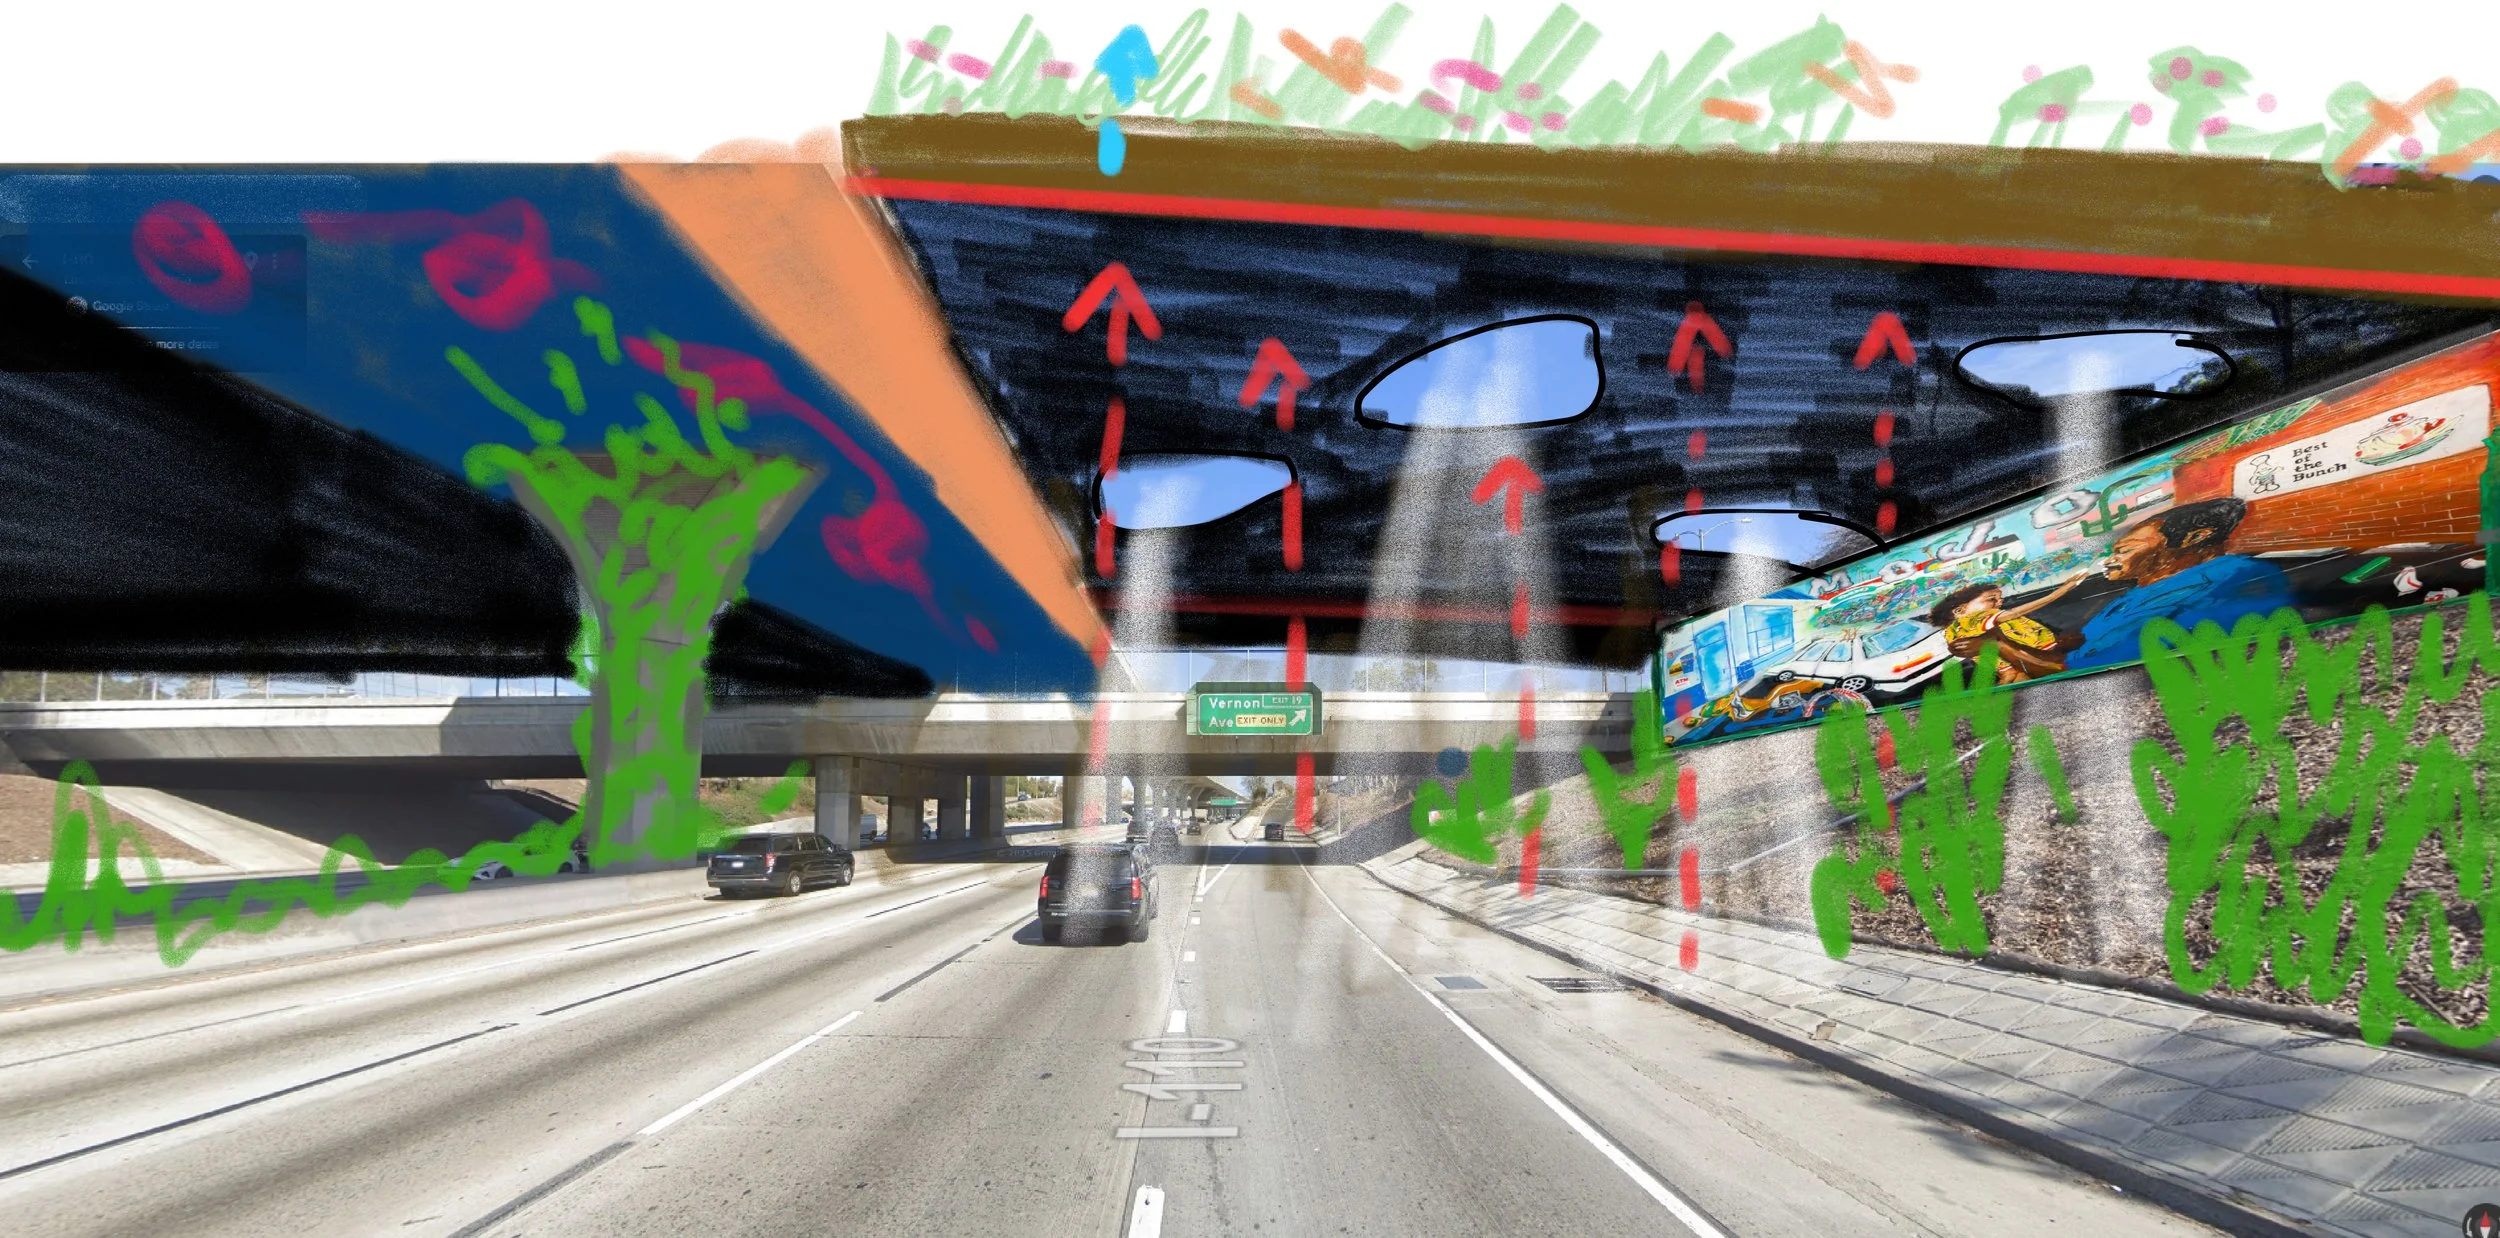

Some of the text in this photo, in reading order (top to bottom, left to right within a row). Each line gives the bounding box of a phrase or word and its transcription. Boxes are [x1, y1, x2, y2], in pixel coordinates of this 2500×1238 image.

[2292, 441, 2329, 458] Best
[2294, 453, 2312, 464] of
[2294, 460, 2323, 473] the
[2292, 463, 2348, 483] Bunch
[1208, 697, 1260, 709] Vernon
[1271, 695, 1303, 705] EXIT 19
[1208, 716, 1234, 728] Ave
[1236, 717, 1285, 725] EXIT ONLY
